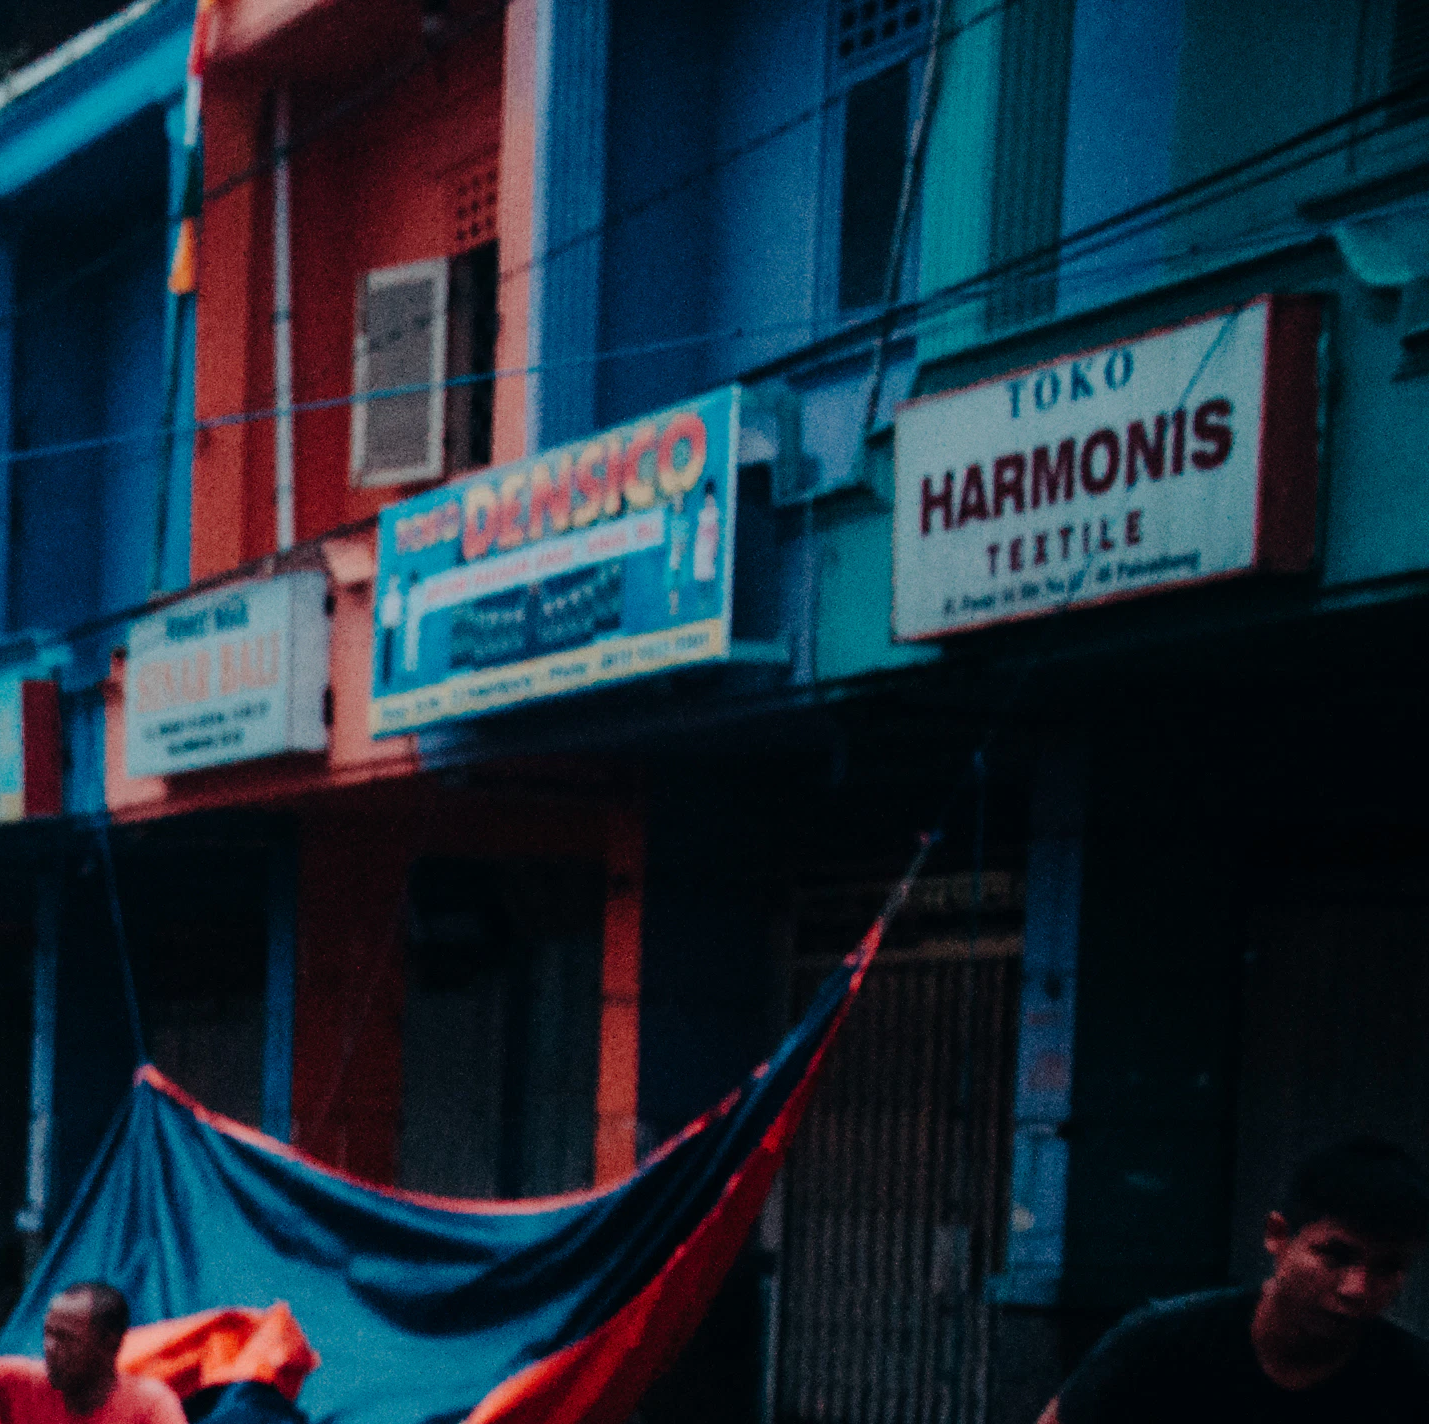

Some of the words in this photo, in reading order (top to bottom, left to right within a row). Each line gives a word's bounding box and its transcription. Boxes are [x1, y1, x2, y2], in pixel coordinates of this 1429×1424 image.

[1005, 349, 1134, 418] TOKO
[461, 412, 706, 559] DENSICO
[920, 398, 1233, 535] HARMONIS
[986, 510, 1144, 577] TEXTILE
